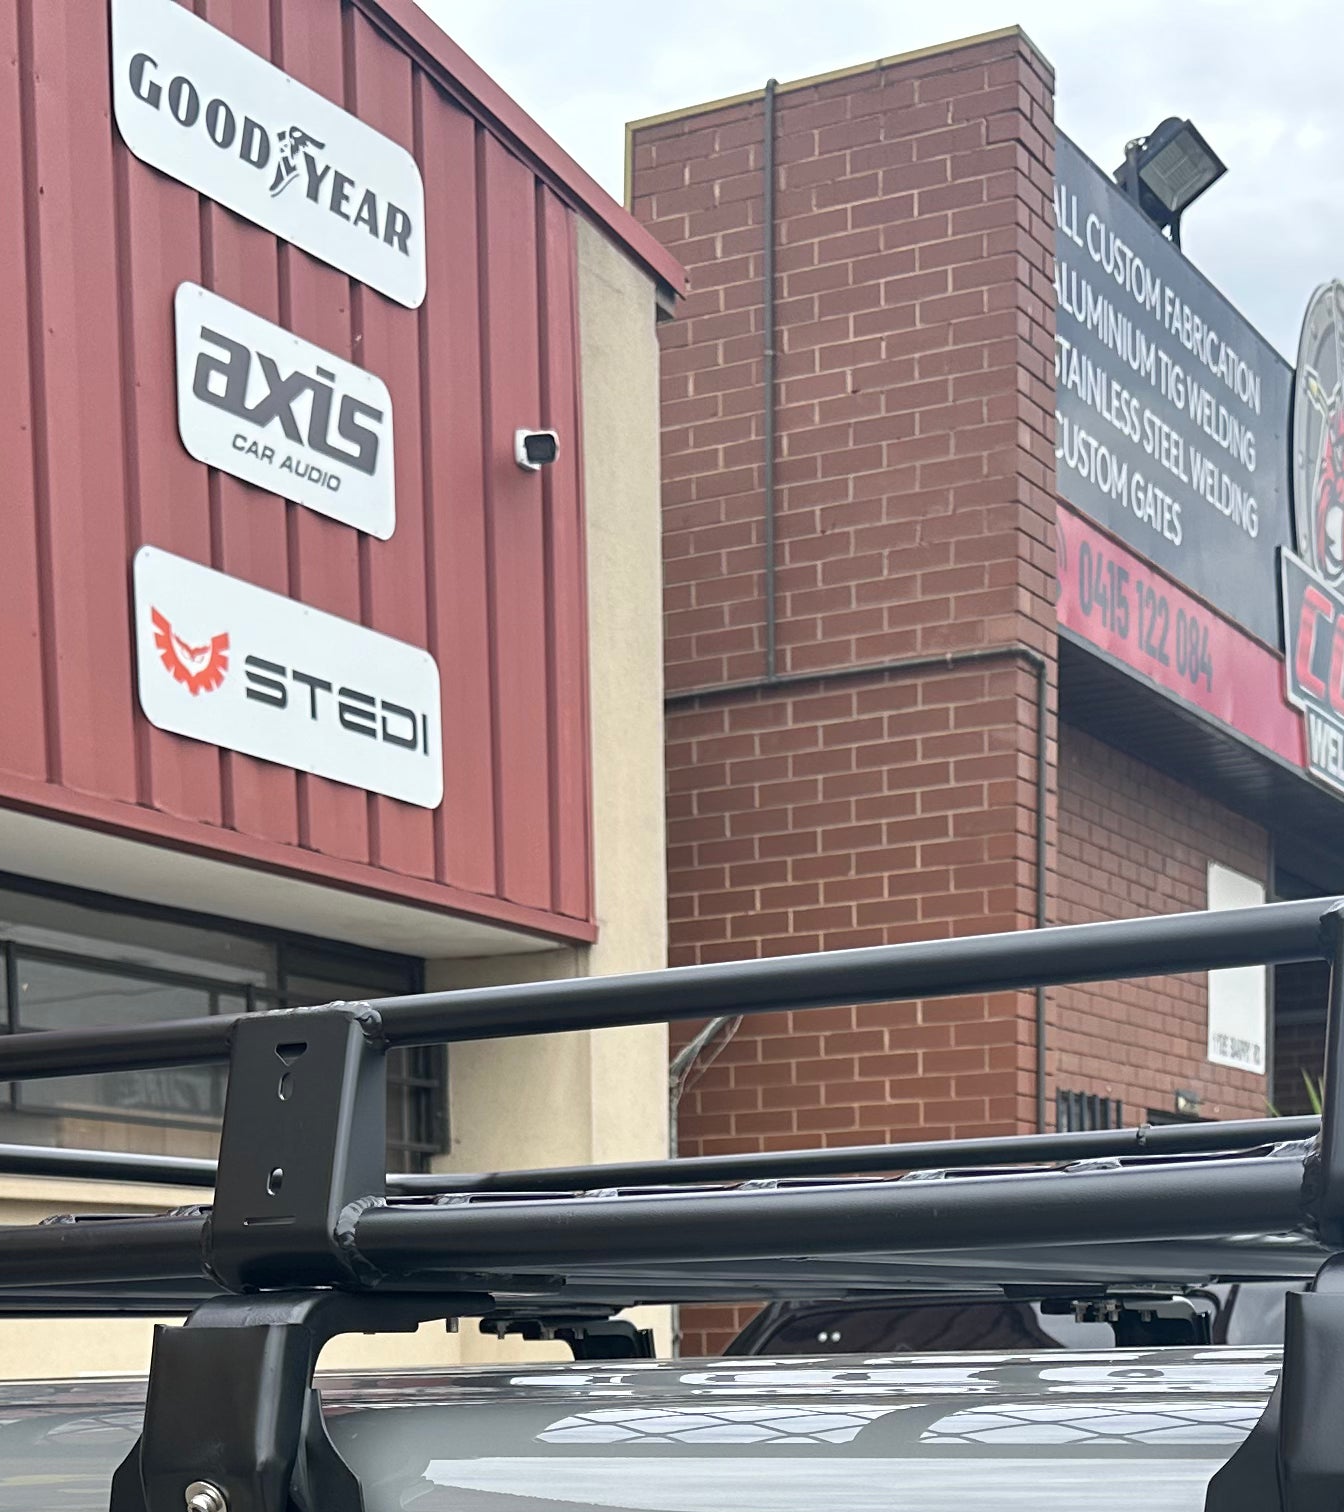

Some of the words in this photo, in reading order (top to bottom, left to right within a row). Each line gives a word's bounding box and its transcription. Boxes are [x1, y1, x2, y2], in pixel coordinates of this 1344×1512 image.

[1086, 213, 1161, 320] CUSTOM
[1164, 286, 1261, 415] FABRICATION
[231, 433, 275, 465] CAR
[278, 450, 342, 493] AUDIO
[1158, 349, 1185, 410] TIG
[1187, 375, 1256, 472] WELDING
[1131, 471, 1182, 546] GATES
[1143, 408, 1189, 483] STEEL
[1190, 446, 1258, 538] WELDING
[1079, 541, 1130, 640] 0415
[1136, 580, 1170, 667] 122
[1176, 608, 1213, 693] 084
[244, 654, 430, 757] STEDI
